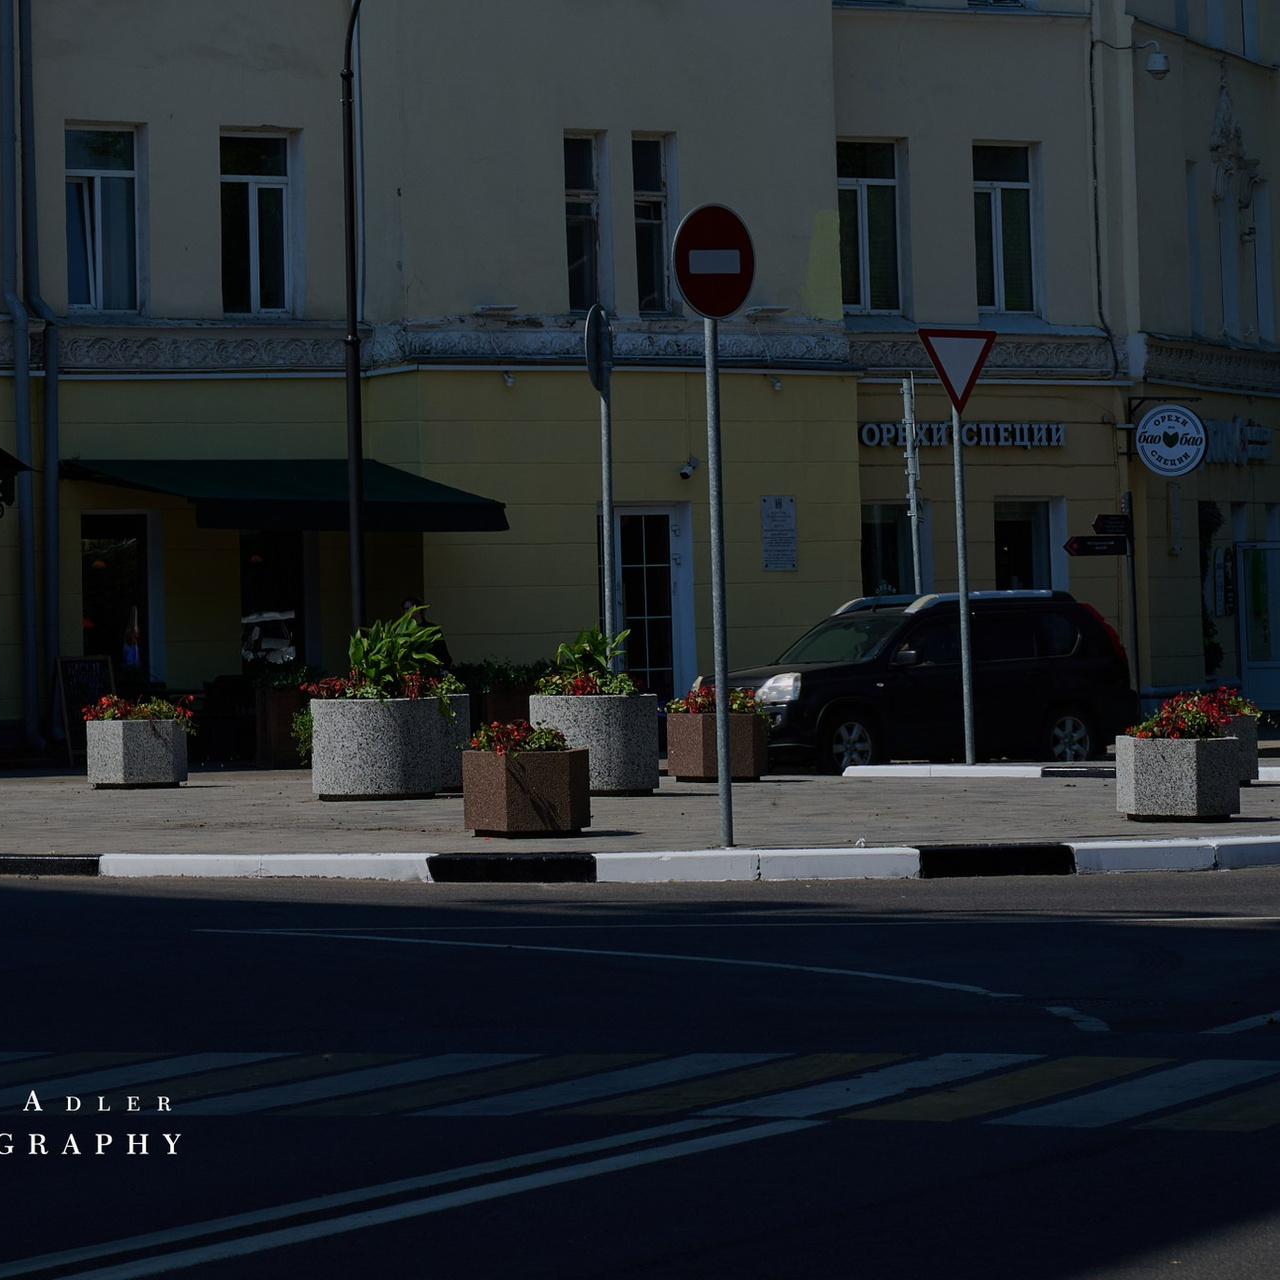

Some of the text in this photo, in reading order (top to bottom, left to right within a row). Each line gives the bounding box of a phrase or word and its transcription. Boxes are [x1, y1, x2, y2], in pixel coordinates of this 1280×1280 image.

[1154, 414, 1189, 427] ОРЕХИ
[961, 423, 1065, 449] СПЕЦИИ
[1151, 450, 1190, 466] СПЕЦИИ
